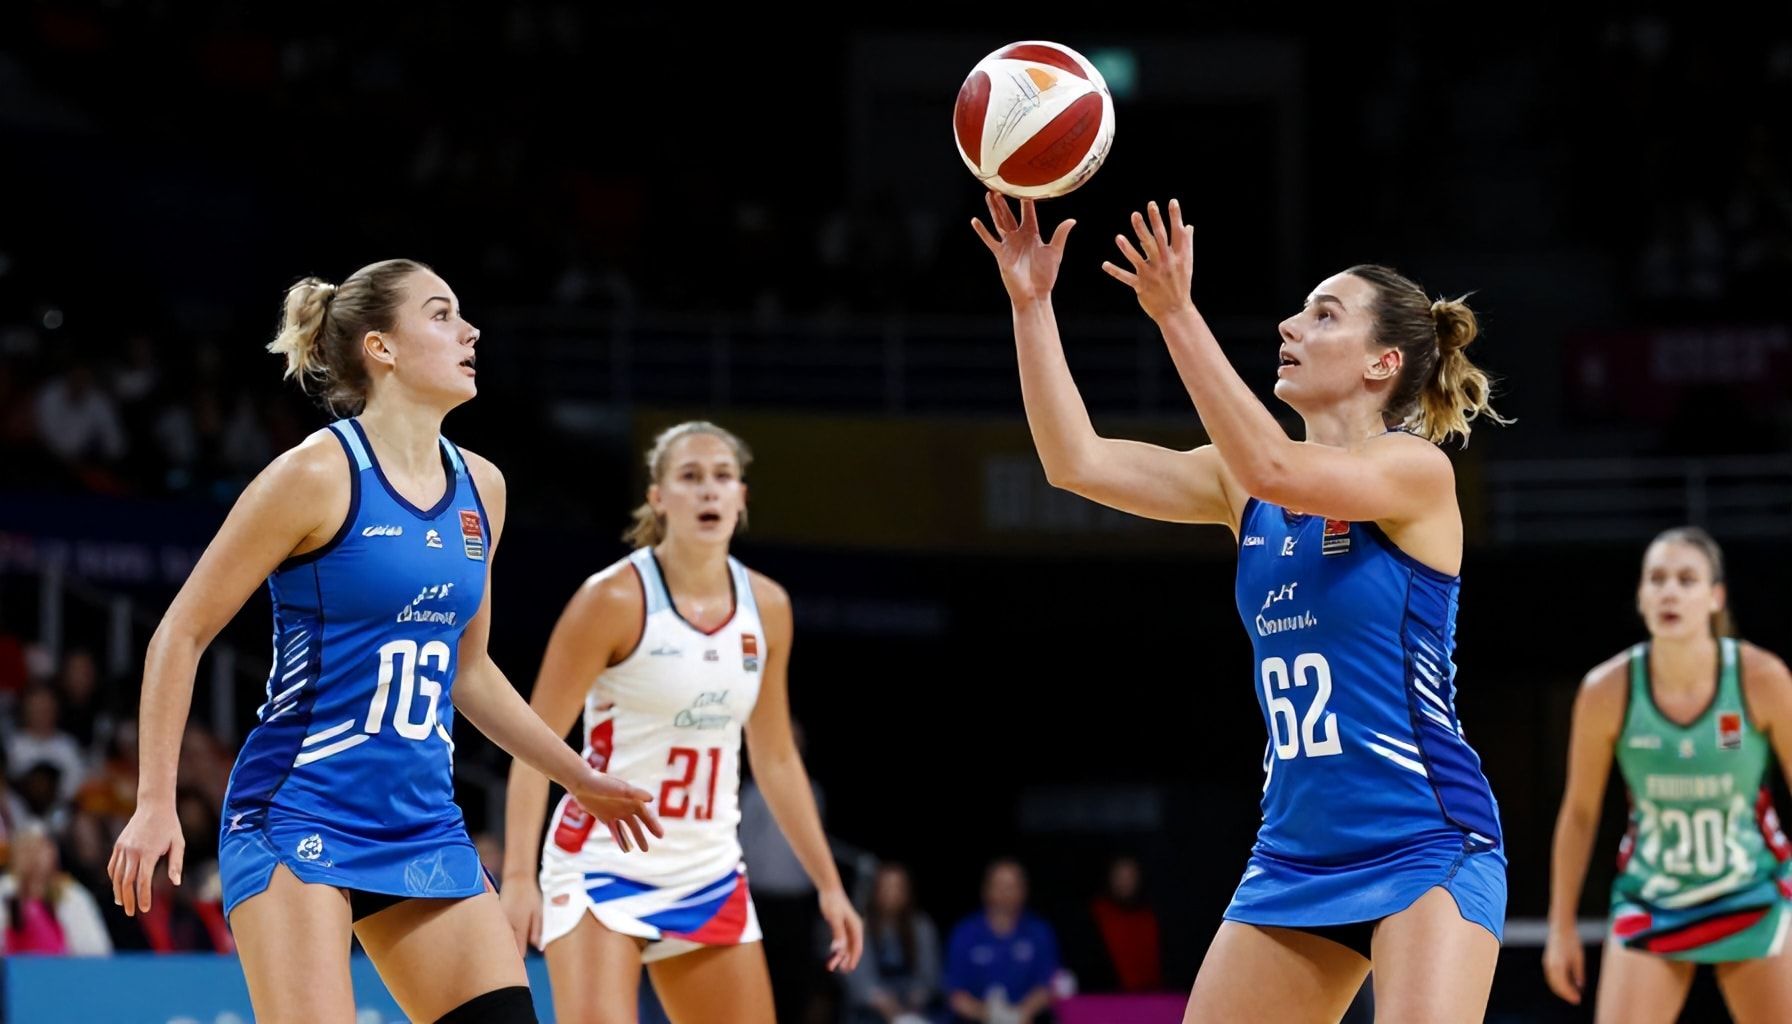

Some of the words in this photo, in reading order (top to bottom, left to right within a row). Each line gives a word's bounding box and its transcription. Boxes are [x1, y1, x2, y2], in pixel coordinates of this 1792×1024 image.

[1261, 652, 1343, 760] 62
[658, 746, 722, 821] 21
[1661, 809, 1725, 876] 20
